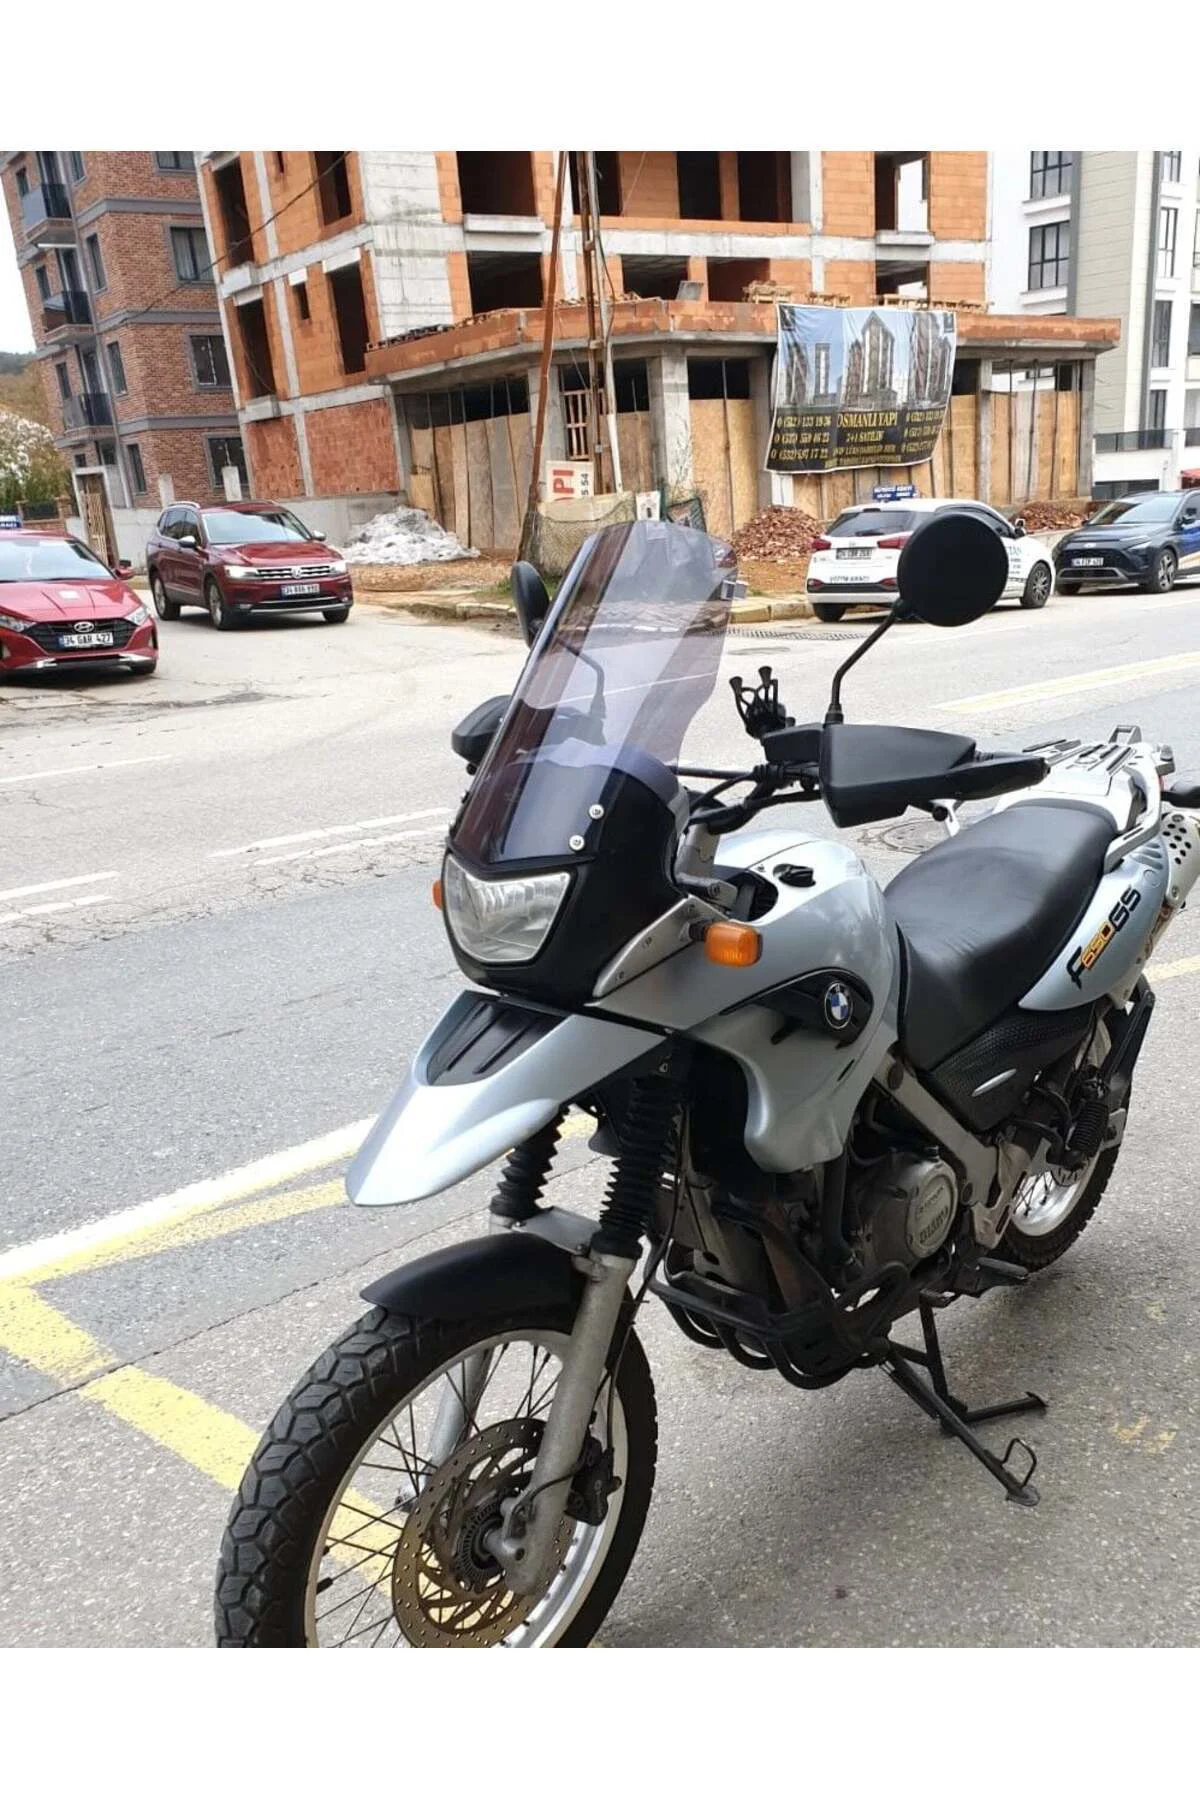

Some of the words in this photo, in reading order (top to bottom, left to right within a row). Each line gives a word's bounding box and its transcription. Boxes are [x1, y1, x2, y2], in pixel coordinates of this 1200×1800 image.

[836, 412, 877, 428] OSMANLI
[879, 411, 898, 427] YAPI
[553, 469, 575, 503] PI
